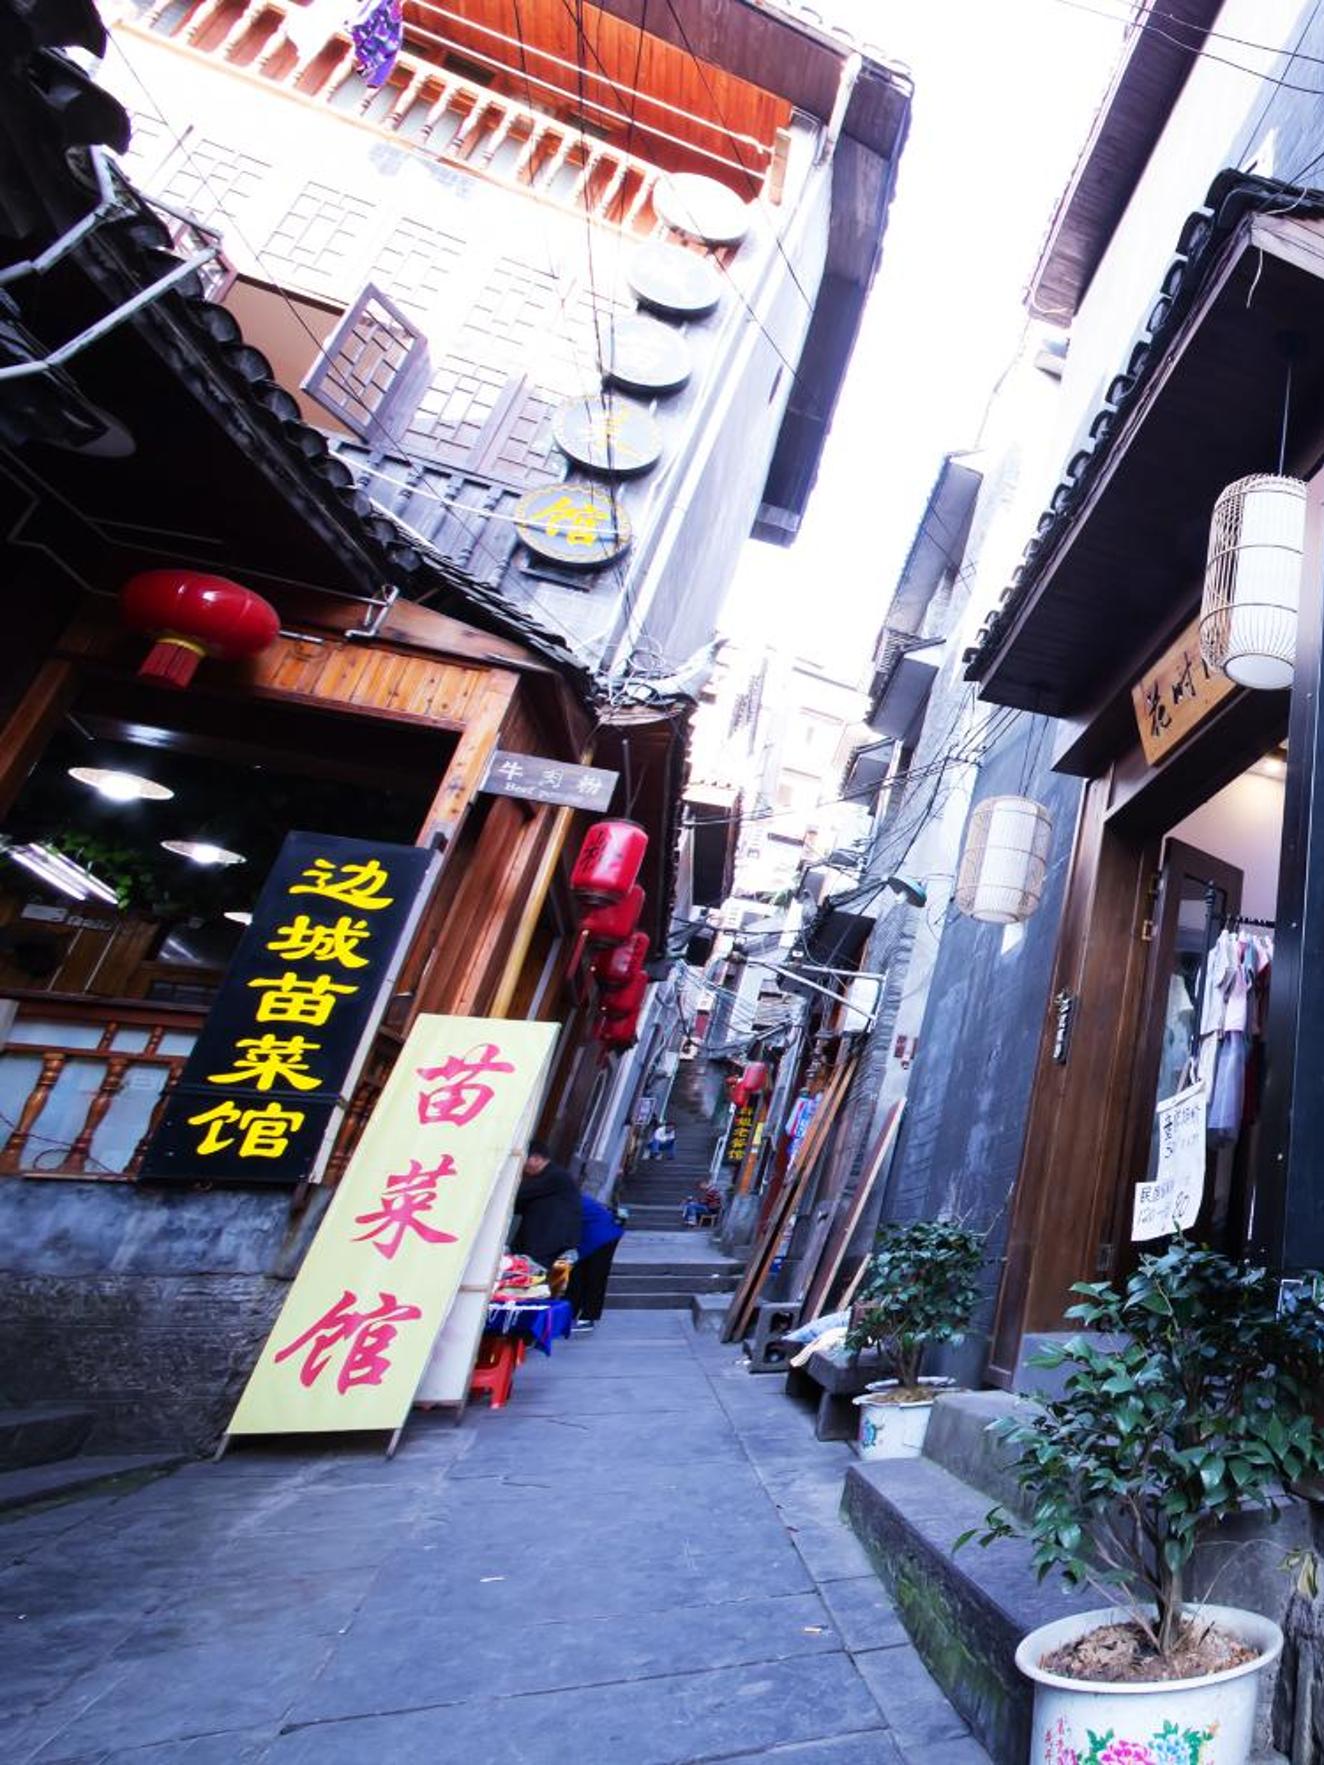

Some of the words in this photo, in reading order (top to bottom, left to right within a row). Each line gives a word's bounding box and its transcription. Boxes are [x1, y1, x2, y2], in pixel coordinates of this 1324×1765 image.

[498, 760, 603, 796] 牛肉粉
[188, 858, 395, 1160] 边城苗菜馆
[275, 1043, 515, 1395] 苗菜馆
